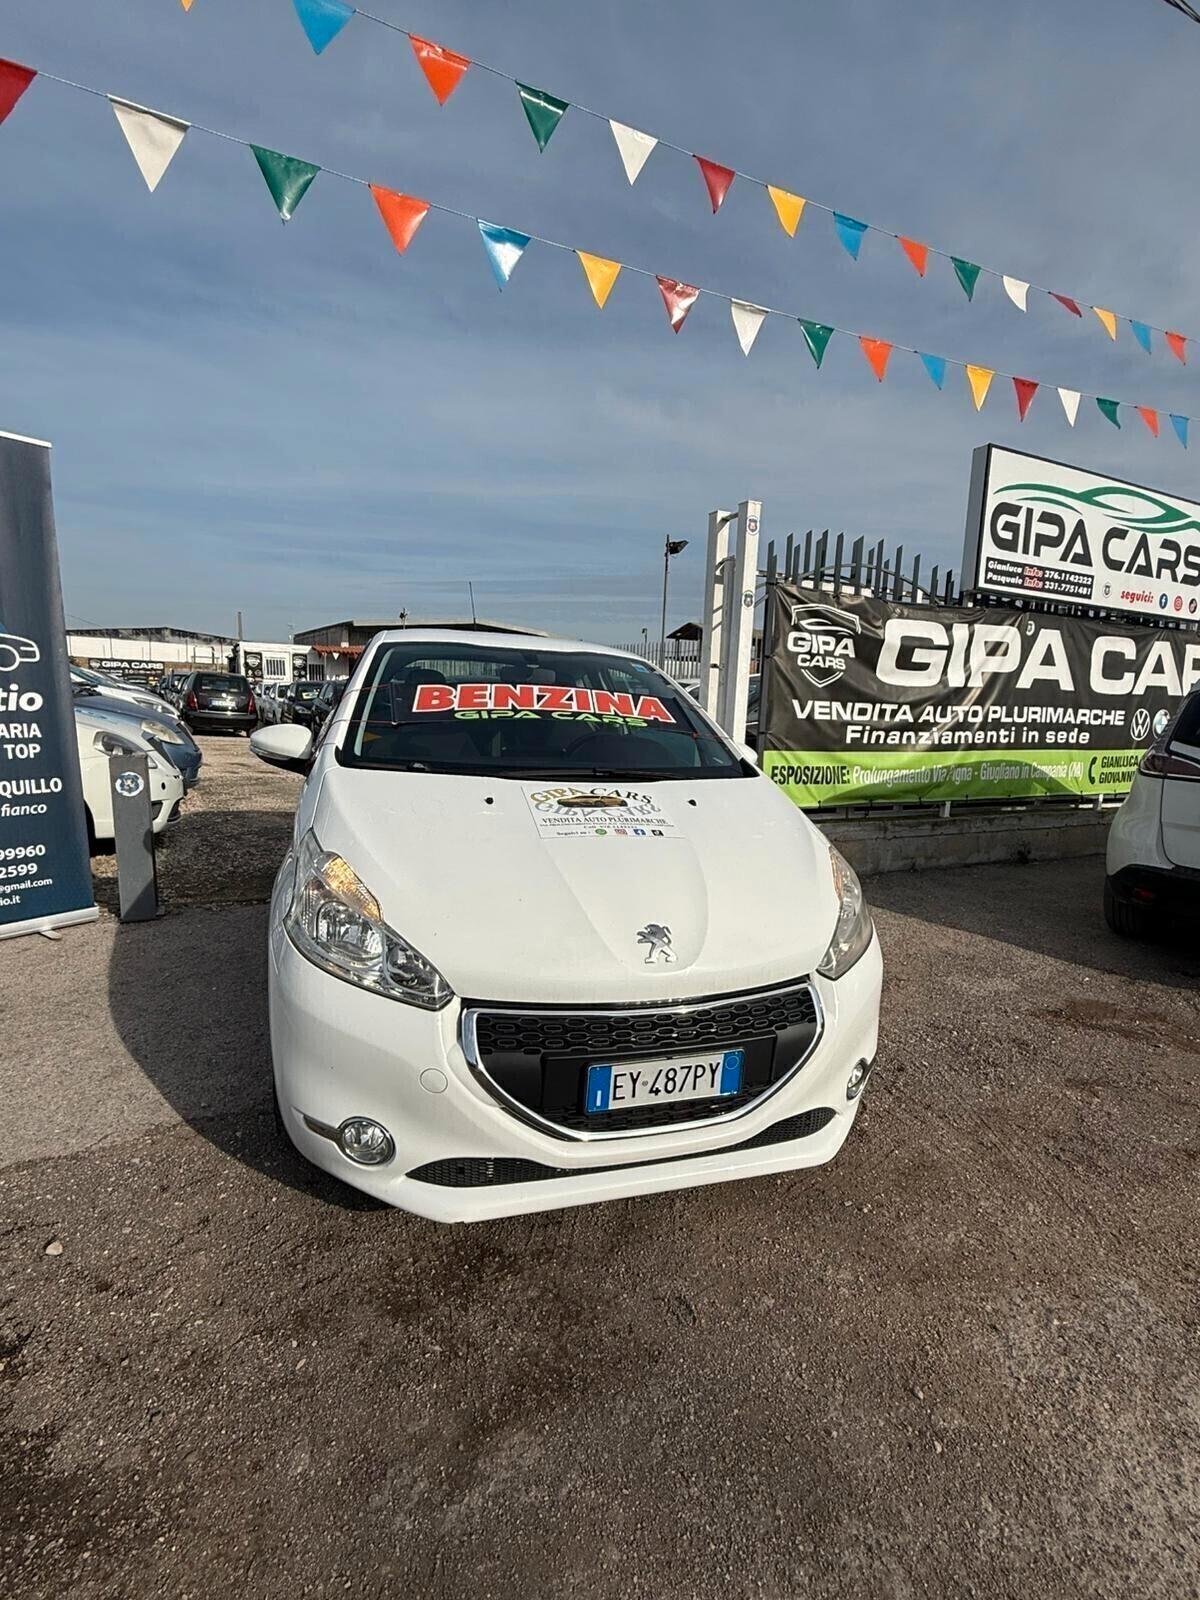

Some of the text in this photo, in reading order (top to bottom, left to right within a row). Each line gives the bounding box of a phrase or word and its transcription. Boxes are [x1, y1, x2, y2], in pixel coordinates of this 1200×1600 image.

[989, 501, 1093, 568] GIPA
[987, 560, 1022, 574] Gianluca
[986, 572, 1022, 586] Pasquale
[1120, 588, 1154, 605] seguici:
[786, 631, 856, 658] GIPA
[797, 654, 846, 670] CARS
[876, 618, 1075, 692] GIPA
[102, 661, 164, 670] GIPA CARS
[0, 683, 43, 712] tio
[412, 683, 677, 724] BENZINA
[454, 710, 649, 728] GIPA CARS
[791, 699, 1126, 727] VENDITA AUTO PLURIMARCHE
[0, 722, 43, 739] ARIA
[845, 725, 1090, 745] Finanziamenti in sede
[3, 743, 42, 760] TOP
[1101, 755, 1139, 769] GIANLUCA
[770, 765, 851, 786] ESPOSIZIONE:
[852, 765, 931, 788] Prolungamento
[932, 764, 947, 783] Via
[980, 761, 1021, 784] Giugliano
[1021, 761, 1030, 779] in
[1030, 761, 1068, 784] Campania
[0, 777, 63, 799] QUILLO
[589, 787, 653, 804] CARS
[1, 803, 48, 817] fianco
[583, 816, 608, 824] AUTO
[608, 816, 669, 825] PLURIMARCHE
[612, 1070, 642, 1101] EY
